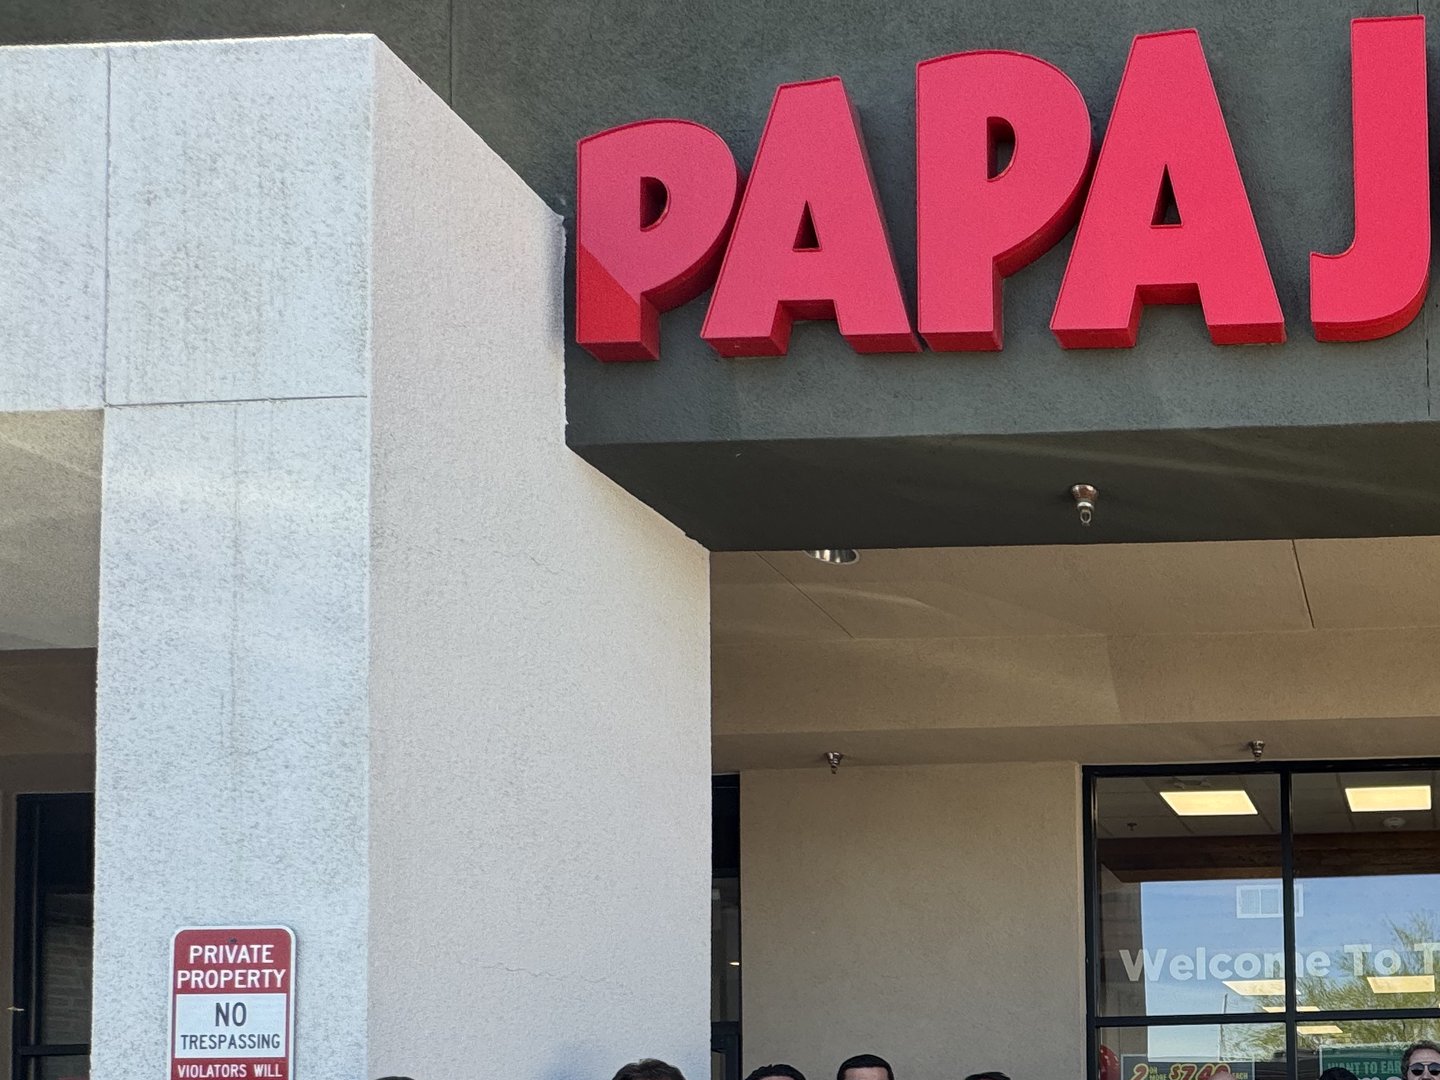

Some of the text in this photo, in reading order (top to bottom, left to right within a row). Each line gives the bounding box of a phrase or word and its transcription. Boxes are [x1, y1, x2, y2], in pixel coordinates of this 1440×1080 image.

[576, 28, 1286, 362] PAPA
[189, 944, 275, 964] PRIVATE
[1119, 946, 1331, 982] Welcome
[1344, 943, 1401, 976] To
[176, 969, 286, 989] PROPERTY
[215, 1002, 247, 1027] NO
[181, 1033, 280, 1050] TRESPASSING
[177, 1063, 283, 1078] VIOLATORS WILL
